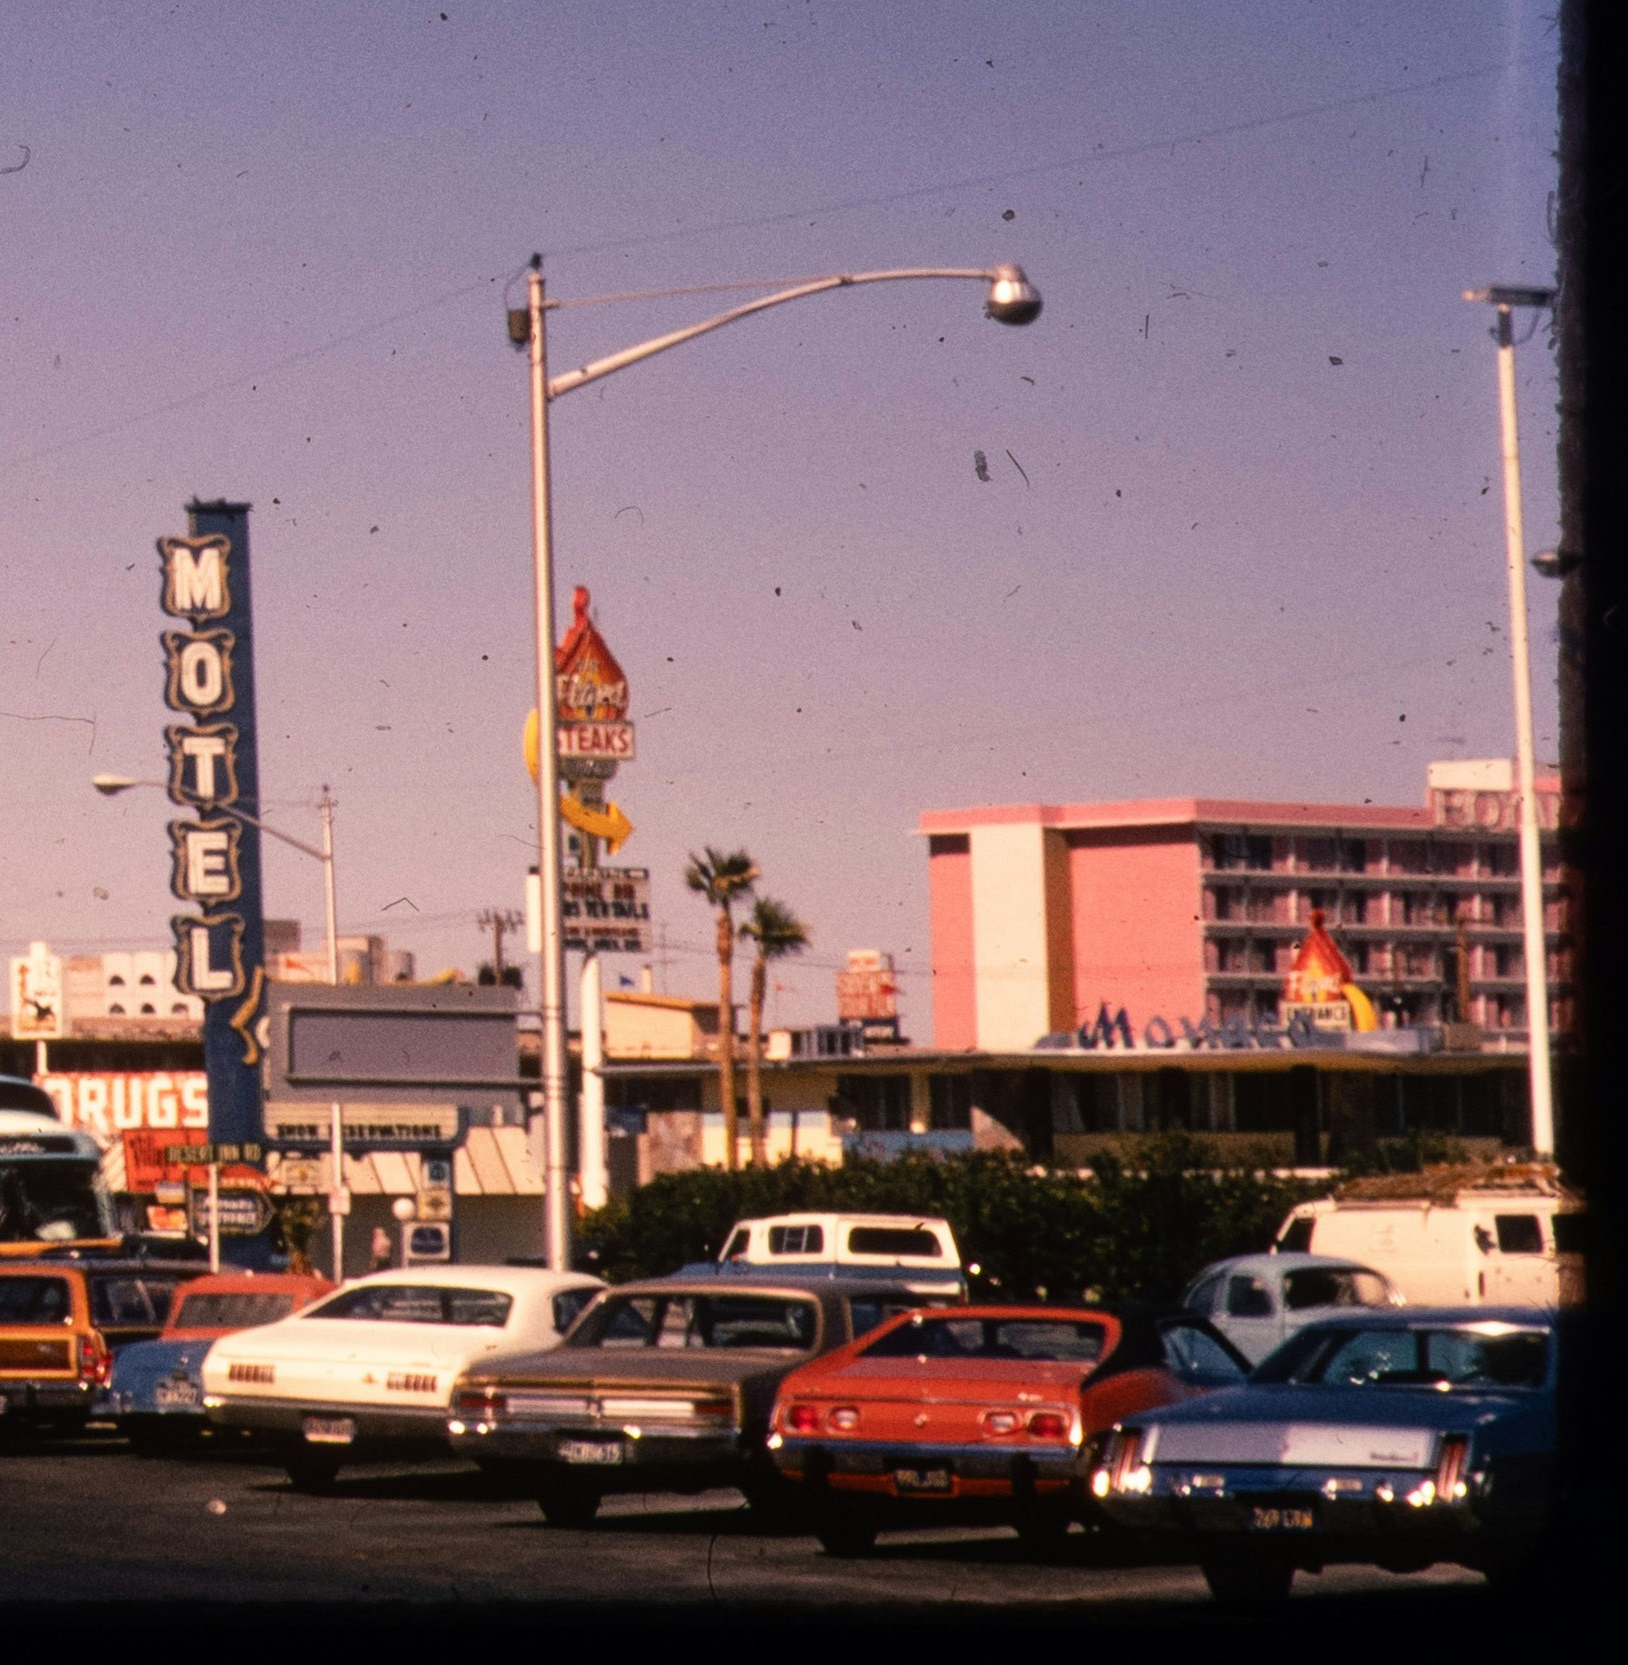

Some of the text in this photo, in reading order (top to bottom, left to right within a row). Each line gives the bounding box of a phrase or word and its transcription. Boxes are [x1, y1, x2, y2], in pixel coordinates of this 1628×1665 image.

[169, 545, 234, 992] MOTEL
[44, 1077, 209, 1130] DRUGS
[165, 1144, 214, 1163] DESERT
